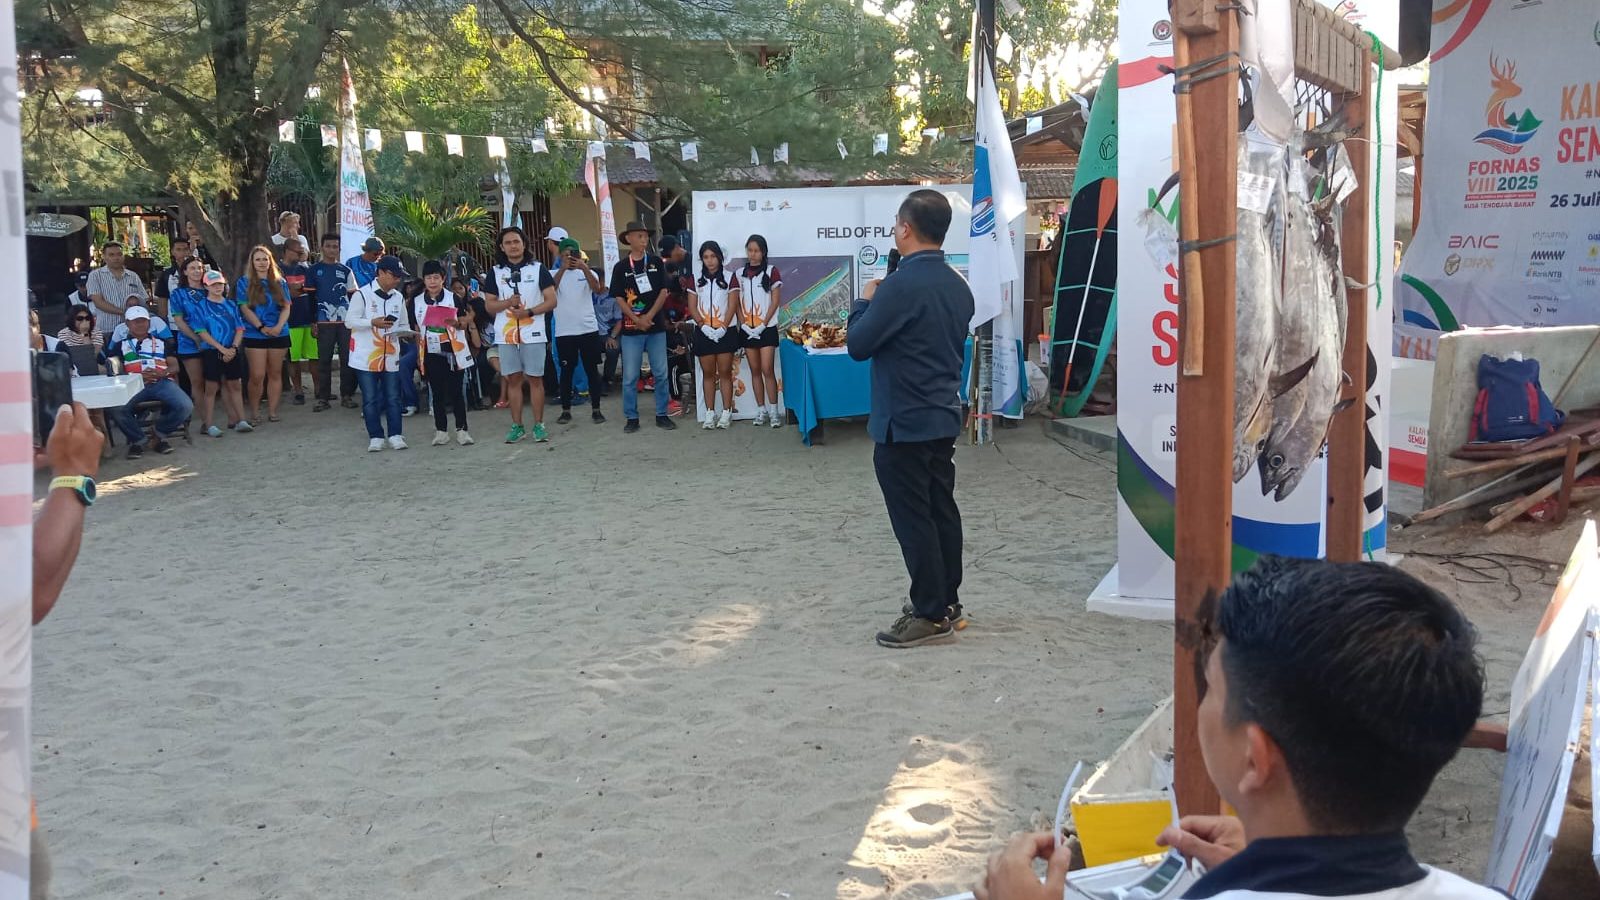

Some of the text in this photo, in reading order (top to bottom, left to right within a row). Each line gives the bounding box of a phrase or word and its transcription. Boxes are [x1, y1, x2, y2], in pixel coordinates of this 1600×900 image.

[1468, 157, 1541, 176] FORNAS
[1467, 175, 1539, 193] VIII 2025
[1550, 194, 1568, 208] 26
[817, 227, 852, 238] FIELD
[854, 226, 871, 238] OF
[1448, 235, 1500, 248] BAIC
